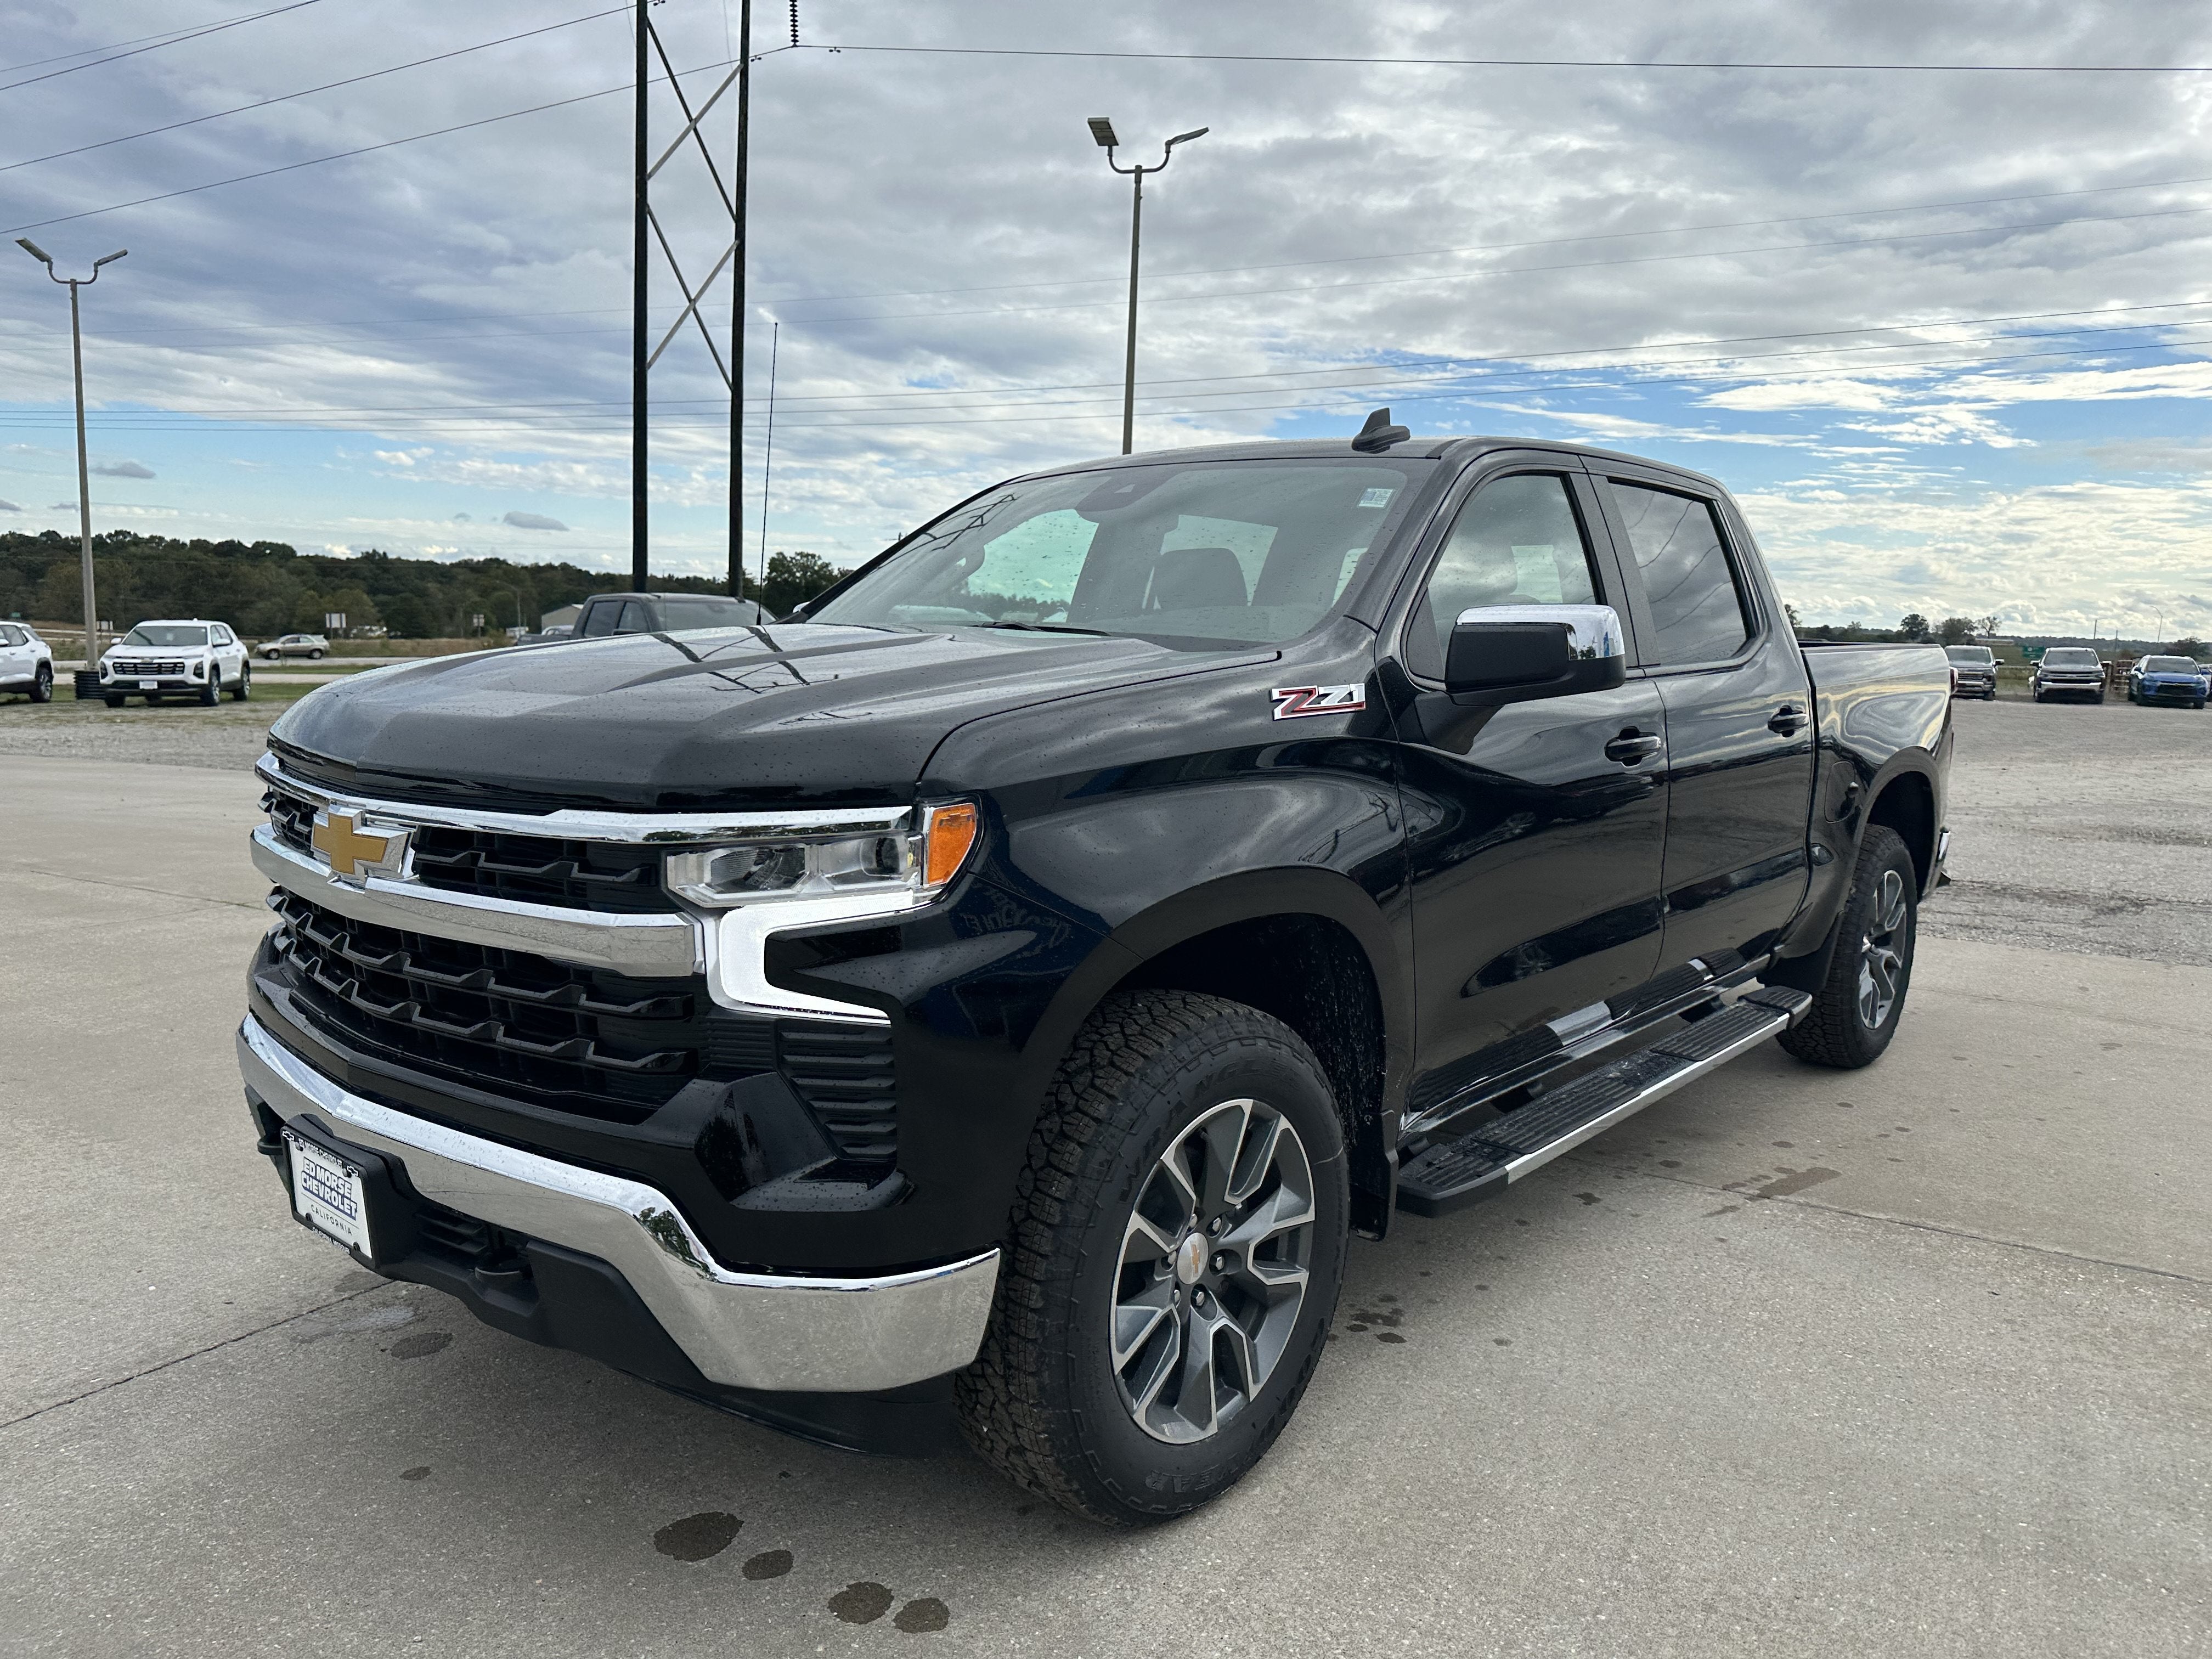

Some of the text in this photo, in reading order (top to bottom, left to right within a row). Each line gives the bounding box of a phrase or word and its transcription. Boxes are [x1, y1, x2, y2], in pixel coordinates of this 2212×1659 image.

[1270, 683, 1365, 720] Z71
[301, 1170, 357, 1221] CHEVROLET
[303, 1156, 352, 1199] ED MORSE
[311, 1204, 352, 1235] CALIFORNIA
